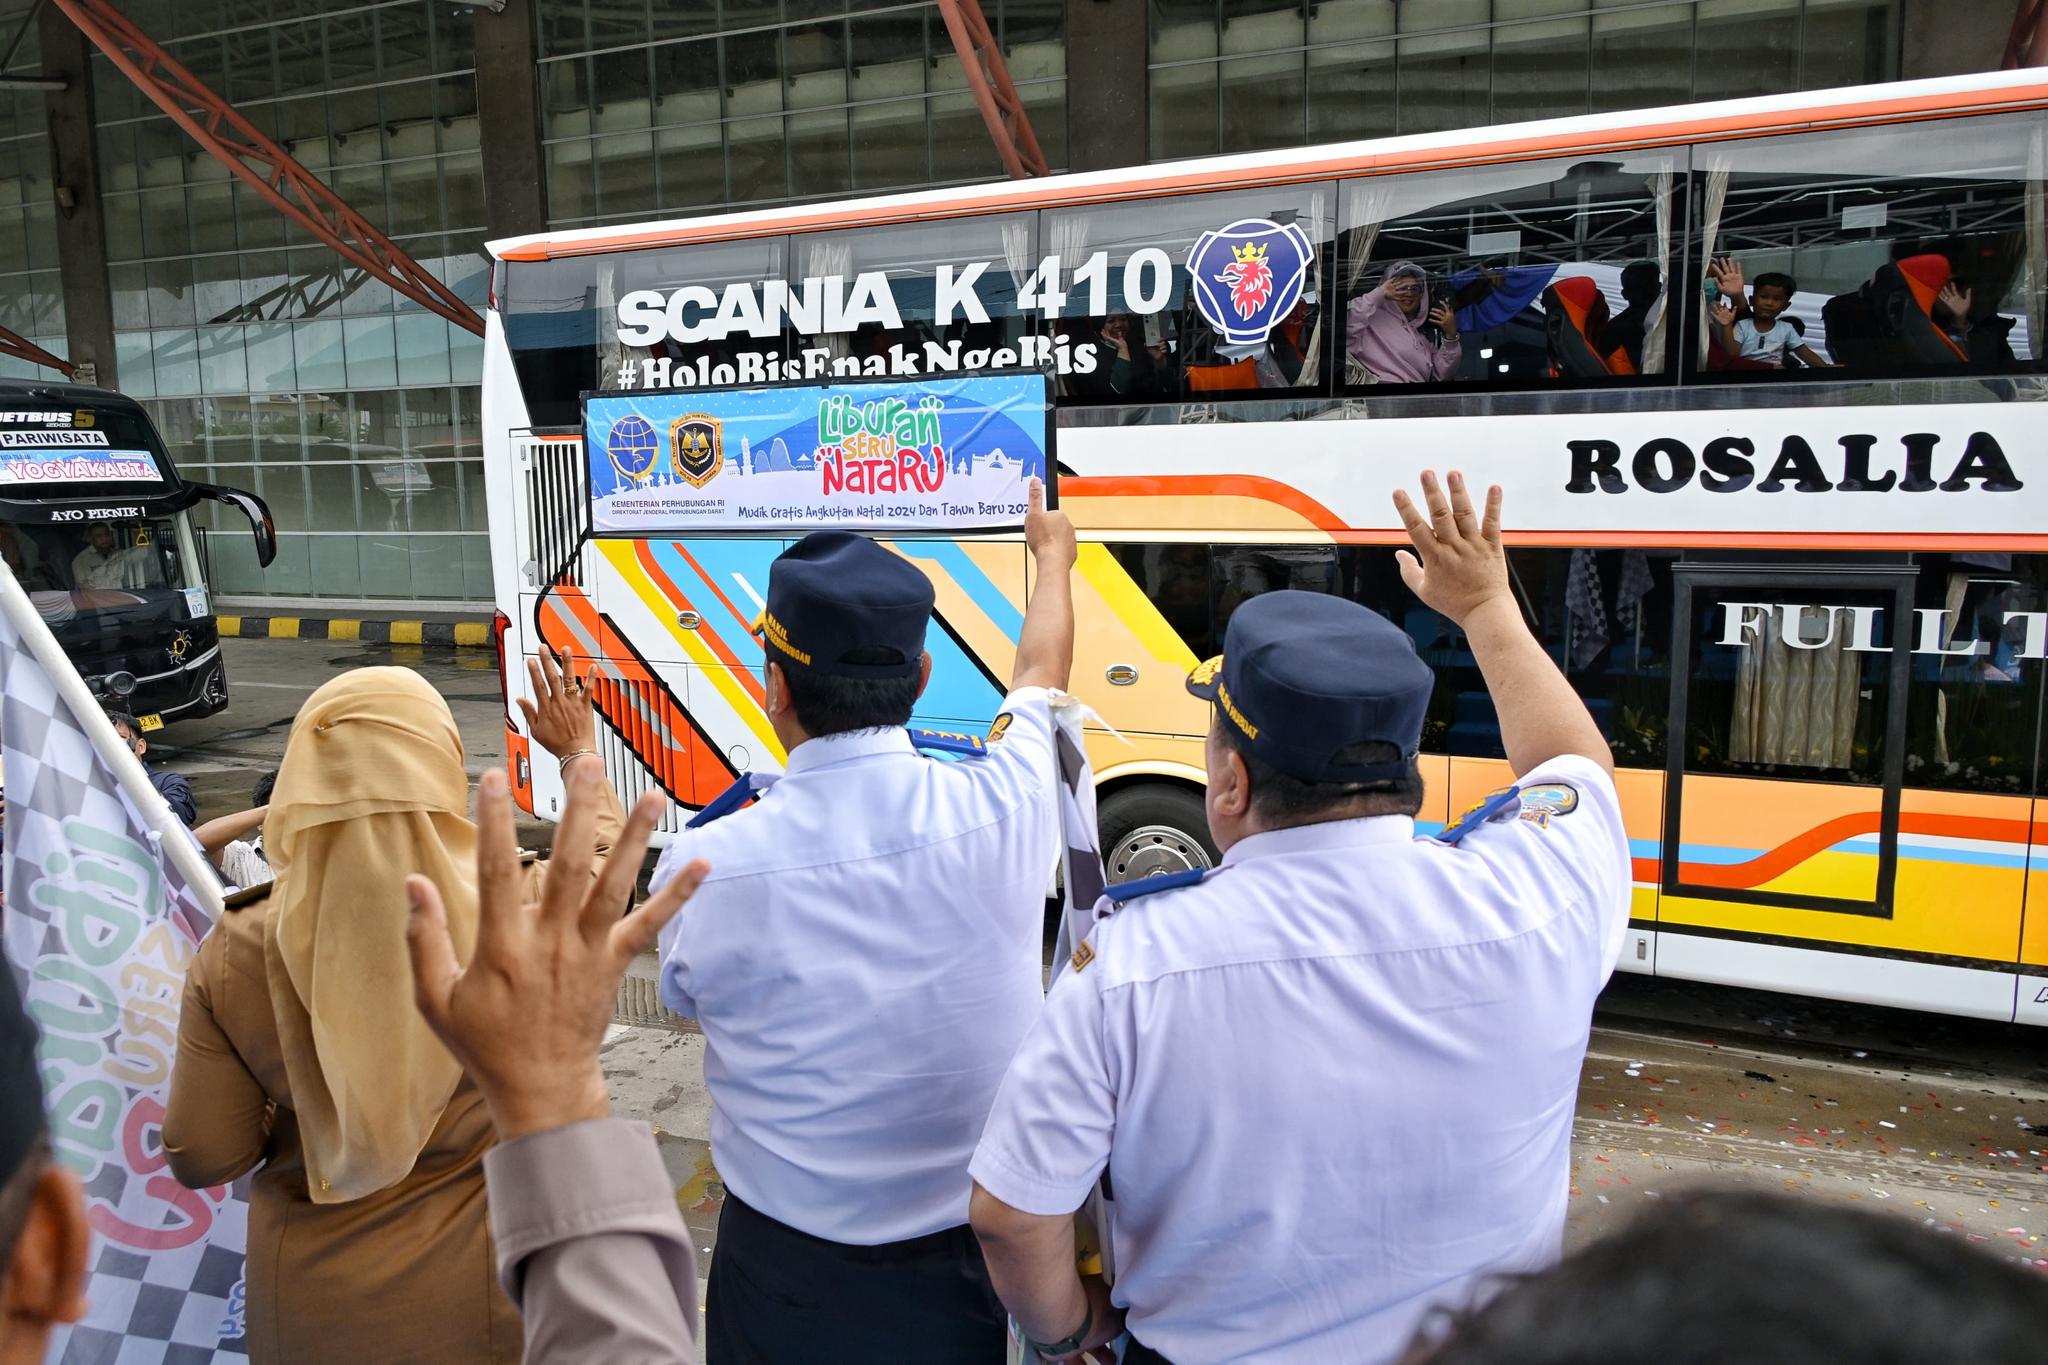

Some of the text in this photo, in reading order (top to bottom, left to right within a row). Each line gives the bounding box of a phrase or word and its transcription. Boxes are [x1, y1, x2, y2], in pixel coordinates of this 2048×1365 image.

[617, 248, 1173, 347] SCANIA K 410
[0, 409, 96, 427] ETBUS 5
[820, 396, 943, 448] Liburan
[2, 433, 104, 444] PARIWISATA
[842, 432, 895, 460] SERU
[5, 461, 159, 480] YOGYAKARTA
[1565, 431, 2023, 493] ROSALIA
[611, 500, 660, 508] KEMENTERIAN
[738, 502, 1029, 521] Mudik Gratis Angkutan Natal 2024 Dan Tahun Baru 202
[51, 510, 84, 521] AYO
[85, 507, 139, 519] PIKNIK
[192, 603, 204, 615] 02
[1715, 602, 1978, 655] FULL
